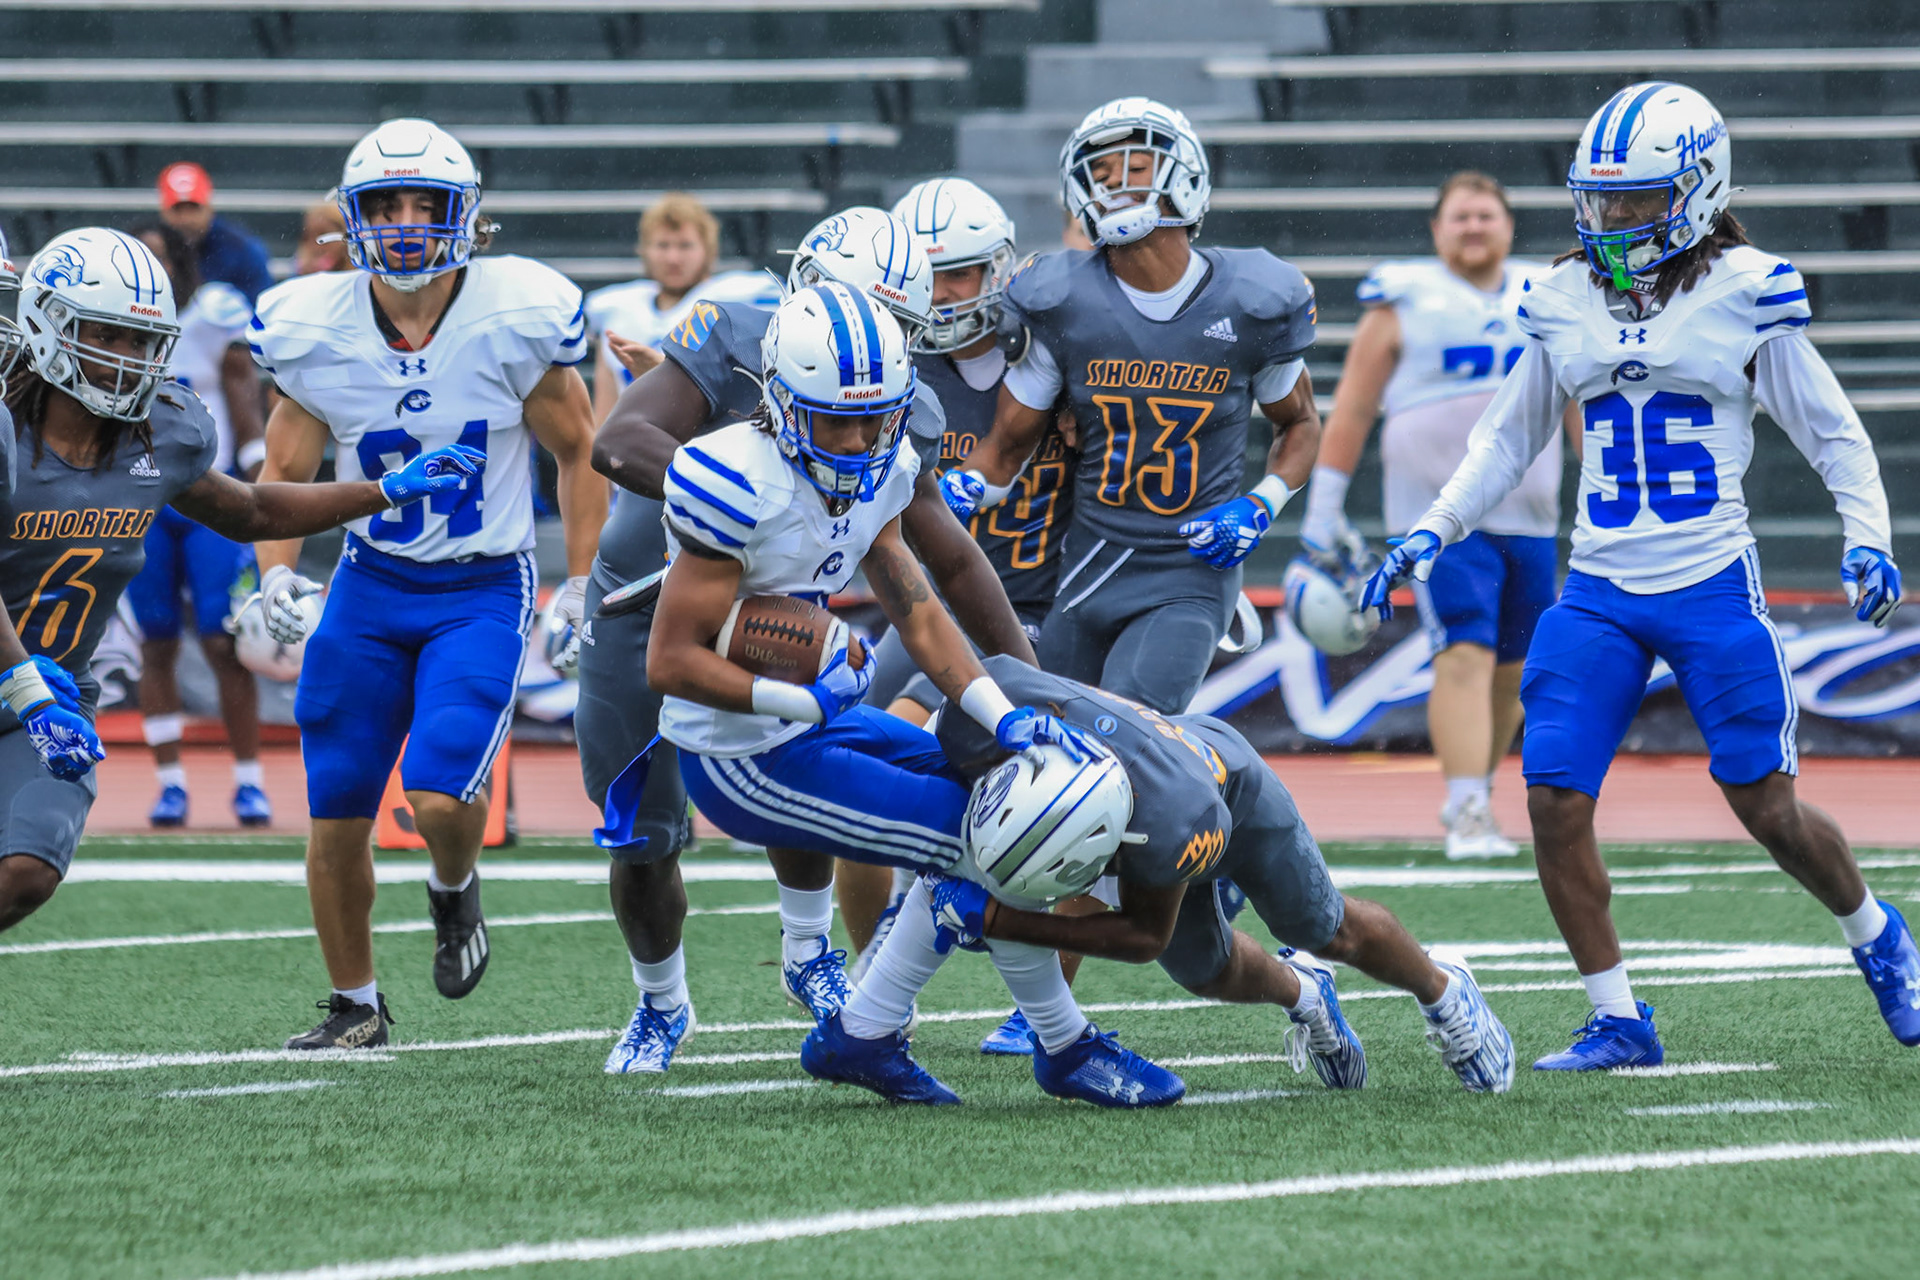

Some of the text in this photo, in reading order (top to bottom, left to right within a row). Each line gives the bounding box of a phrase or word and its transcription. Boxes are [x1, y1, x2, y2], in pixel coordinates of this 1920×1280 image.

[383, 168, 420, 178] Riddell
[1590, 168, 1623, 177] Riddell
[873, 283, 908, 304] Riddell
[130, 305, 163, 318] Riddell
[1203, 329, 1238, 343] adidas
[1085, 360, 1230, 394] SHORTER
[844, 388, 882, 400] Riddell
[1092, 395, 1214, 516] 13
[1584, 391, 1720, 529] 36
[129, 467, 161, 477] adidas
[934, 462, 1065, 569] 4
[14, 548, 104, 663] 6
[745, 643, 798, 668] Wilson
